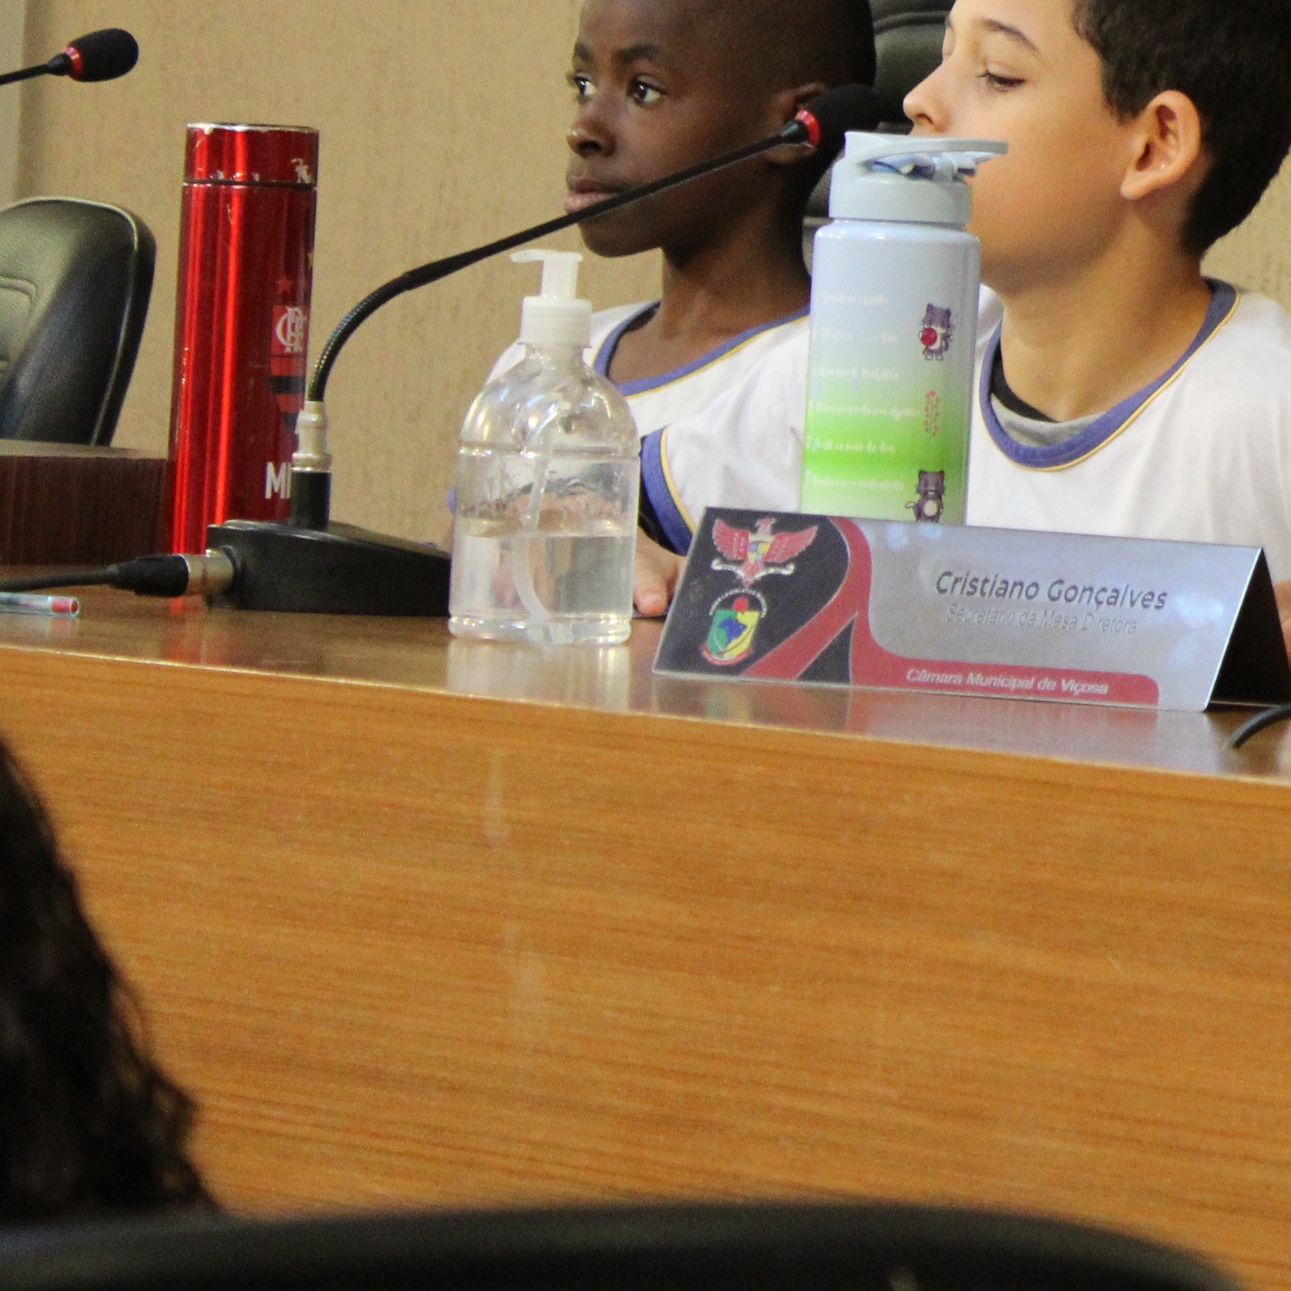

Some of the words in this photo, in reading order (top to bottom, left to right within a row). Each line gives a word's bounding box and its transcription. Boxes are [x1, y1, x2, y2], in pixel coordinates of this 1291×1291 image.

[935, 570, 1039, 601] Cristiano
[1047, 578, 1168, 610] Gonçalves
[1041, 610, 1078, 630] Mesa
[1081, 613, 1138, 634] Diretora
[906, 667, 963, 685] Câmara
[965, 671, 1034, 692] Municipal
[1037, 677, 1057, 692] de
[1060, 678, 1109, 696] Viçosa
